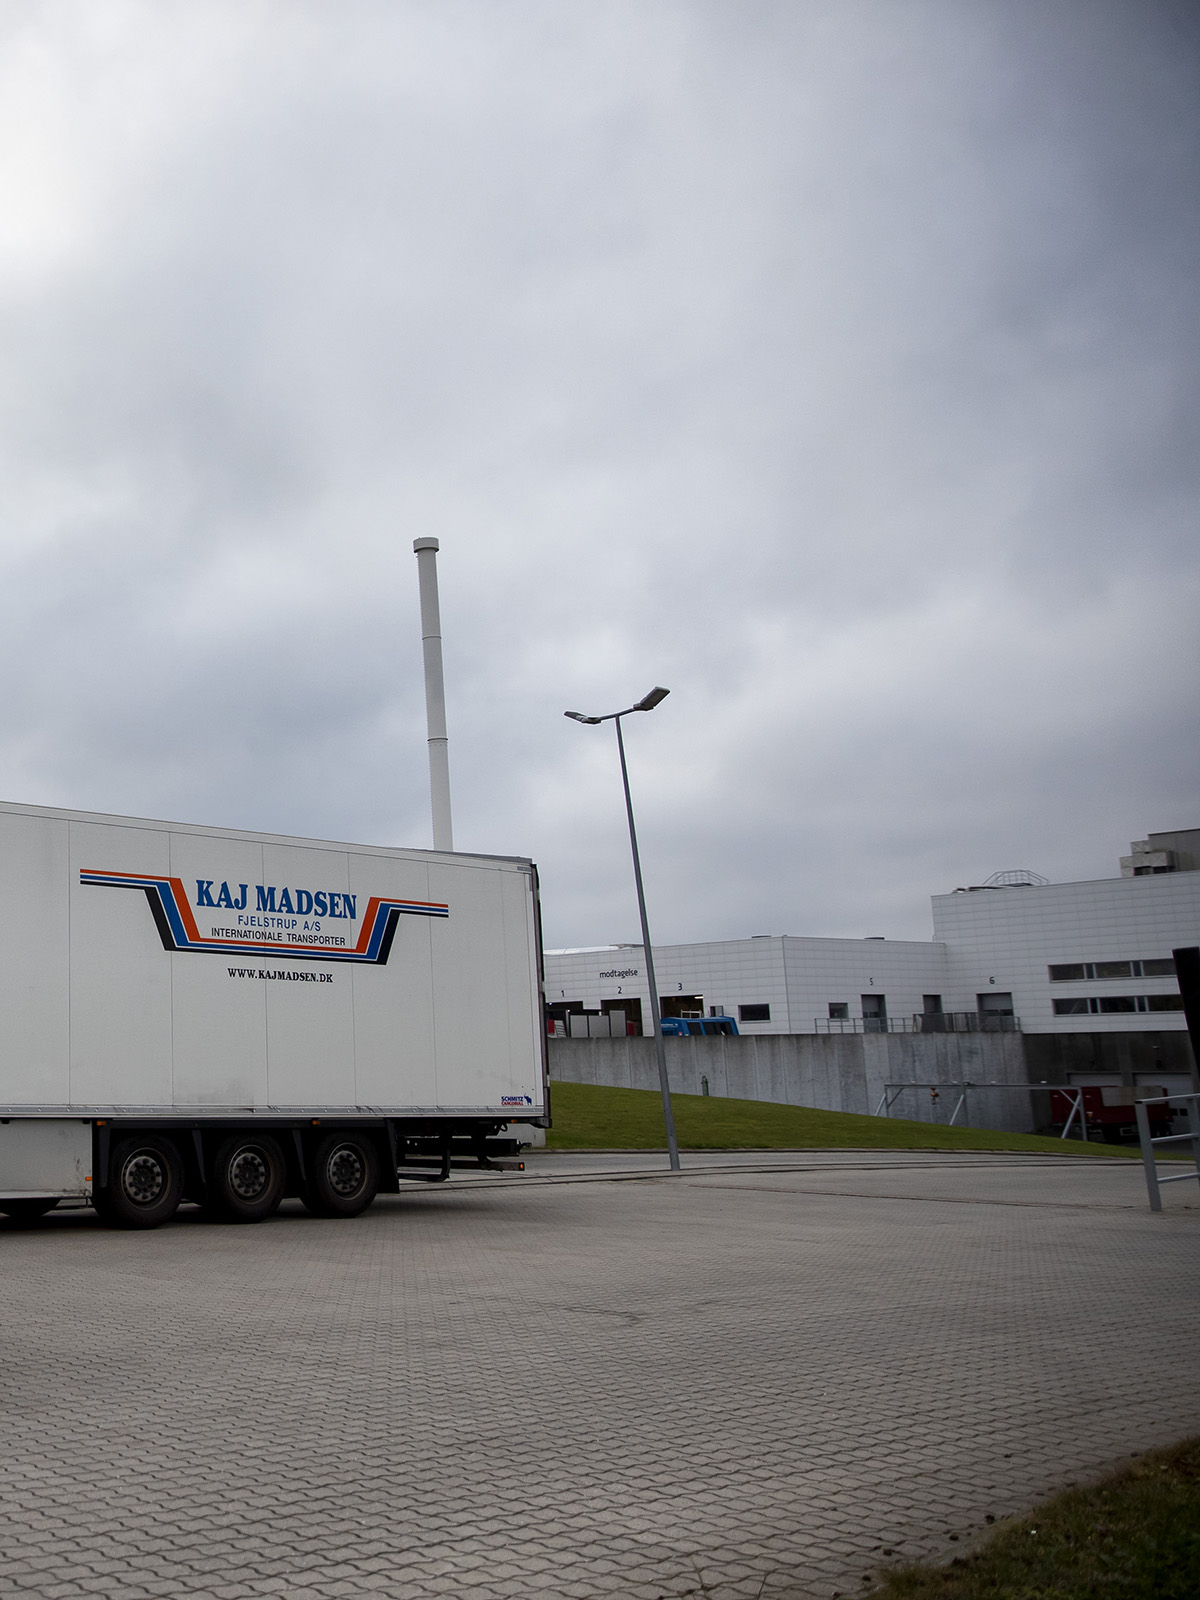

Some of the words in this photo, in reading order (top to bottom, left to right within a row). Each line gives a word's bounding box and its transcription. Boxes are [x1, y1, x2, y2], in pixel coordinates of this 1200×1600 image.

[196, 879, 249, 911] KAJ
[255, 885, 357, 920] MADSEN
[237, 915, 298, 930] FJELSTRUP
[303, 920, 321, 932] A/S
[211, 927, 283, 942] INTERNATIONALE
[286, 933, 346, 946] TRANSPORTER
[227, 967, 334, 983] WWW.KAJMADSEN.DK
[599, 968, 638, 979] modtagelse
[869, 977, 874, 986] 5
[989, 976, 995, 985] 6
[617, 986, 623, 994] 2
[677, 982, 683, 991] 3
[560, 990, 565, 998] 1
